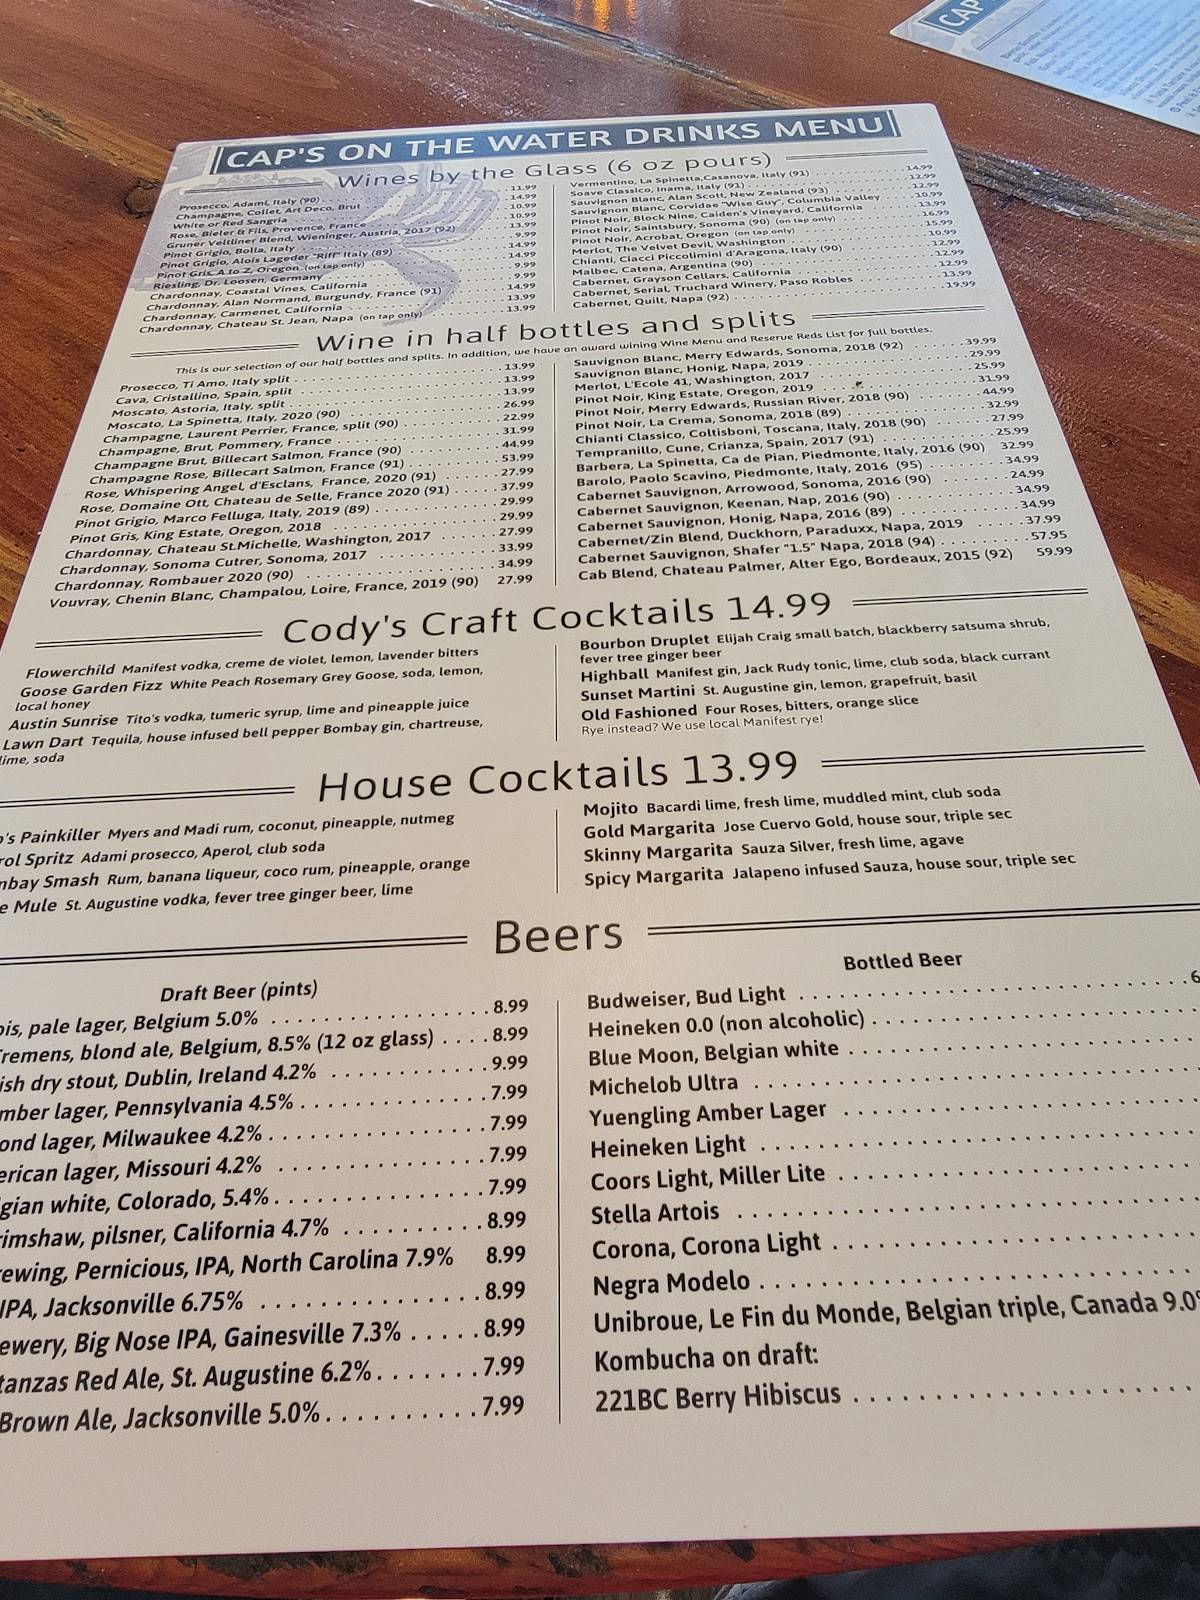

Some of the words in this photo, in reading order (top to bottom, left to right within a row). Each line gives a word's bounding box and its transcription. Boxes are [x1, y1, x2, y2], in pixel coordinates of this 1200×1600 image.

[226, 146, 326, 168] CAP'S
[338, 141, 392, 161] ON
[405, 136, 475, 157] THE
[487, 129, 613, 152] WATER
[625, 122, 761, 145] DRINKS
[774, 116, 883, 138] MENU
[337, 171, 419, 188] Wines
[430, 168, 461, 188] by
[470, 166, 514, 185] the
[524, 162, 597, 180] Glass
[607, 158, 632, 177] (6
[642, 159, 675, 171] oz
[684, 151, 771, 173] pours)
[178, 203, 230, 211] Prosecco,
[231, 199, 270, 208] Adami,
[272, 198, 298, 206] Italy
[299, 196, 320, 205] (90)
[510, 184, 537, 192] 11.99
[152, 280, 202, 290] Riesling,
[203, 279, 221, 287] Dr.
[223, 277, 267, 286] Loosen,
[270, 273, 324, 283] Germany
[514, 261, 536, 269] 9.99
[572, 267, 619, 276] Malbec,
[621, 265, 666, 273] Catena,
[669, 261, 727, 272] Argentina
[730, 258, 753, 269] (90)
[935, 248, 965, 257] 12.99
[572, 299, 631, 309] Cabernet,
[634, 296, 668, 306] Quilt,
[670, 295, 703, 304] Napa
[706, 292, 730, 303] (92)
[945, 280, 976, 289] 19.99
[316, 333, 394, 352] Wine
[407, 329, 433, 347] in
[446, 324, 508, 345] half
[519, 319, 630, 341] bottles
[641, 313, 699, 334] and
[711, 310, 796, 334] splits
[119, 383, 179, 392] Prosecco,
[182, 380, 194, 389] Ti
[196, 380, 229, 388] Amo,
[232, 377, 260, 387] Italy
[262, 375, 290, 386] split
[504, 362, 535, 371] 13.99
[574, 381, 621, 392] Merlot,
[624, 378, 669, 389] L'Ecole
[673, 377, 692, 387] 41,
[694, 374, 776, 385] Washington,
[778, 371, 809, 381] 2017
[973, 361, 1006, 370] 25.99
[577, 520, 643, 532] Cabernet
[647, 516, 725, 529] Sauvignon,
[729, 512, 776, 525] Honig,
[779, 511, 823, 523] Napa,
[825, 508, 861, 519] 2016
[865, 505, 892, 519] (89)
[1019, 499, 1056, 509] 34.99
[50, 597, 111, 608] Vouvray,
[115, 592, 166, 605] Chenin
[170, 591, 214, 602] Blanc,
[218, 585, 306, 600] Champalou,
[310, 583, 351, 595] Loire,
[355, 582, 408, 593] France,
[411, 578, 447, 590] 2019
[451, 575, 479, 590] (90)
[497, 574, 533, 585] 27.99
[283, 614, 406, 647] Cody's
[422, 607, 517, 636] Craft
[533, 597, 714, 630] Cocktails
[727, 592, 831, 621] 14.99
[25, 663, 116, 679] Flowerchild
[121, 662, 177, 674] Manifest
[180, 660, 222, 671] vodka,
[225, 659, 266, 669] creme
[268, 656, 285, 667] de
[288, 655, 327, 666] violet,
[330, 653, 374, 663] lemon,
[377, 649, 435, 661] lavender
[437, 647, 479, 658] bitters
[580, 688, 633, 702] Sunset
[638, 684, 695, 699] Martini
[702, 685, 719, 696] St.
[722, 681, 789, 696] Augustine
[792, 680, 817, 694] gin,
[820, 679, 867, 690] lemon,
[869, 673, 941, 690] grapefruit,
[943, 671, 978, 683] basil
[581, 725, 604, 737] Rye
[607, 722, 659, 734] instead?
[660, 721, 682, 731] We
[684, 721, 706, 730] use
[709, 717, 741, 729] local
[743, 715, 798, 727] Manifest
[800, 714, 824, 726] rye!
[319, 772, 452, 802] House
[469, 755, 668, 795] Cocktails
[683, 750, 797, 785] 13.99
[583, 801, 638, 819] Mojito
[646, 799, 701, 814] Bacardi
[705, 798, 740, 811] lime,
[743, 795, 780, 809] fresh
[783, 795, 819, 807] lime,
[822, 790, 887, 805] muddled
[890, 789, 928, 802] mint,
[931, 787, 963, 800] club
[966, 785, 1001, 798] soda
[495, 919, 623, 954] Beers
[843, 952, 914, 971] Bottled
[918, 952, 963, 967] Beer
[160, 984, 208, 1003] Draft
[212, 984, 257, 1000] Beer
[260, 979, 318, 1002] (pints)
[587, 990, 690, 1010] Budweiser,
[695, 987, 733, 1005] Bud
[738, 985, 786, 1006] Light
[588, 1018, 680, 1038] Heineken
[685, 1016, 714, 1033] 0.0
[719, 1014, 763, 1036] (non
[768, 1008, 864, 1030] alcoholic)
[589, 1074, 682, 1096] Michelob
[687, 1073, 738, 1092] Ultra
[591, 1203, 651, 1225] Stella
[657, 1199, 720, 1222] Artois
[592, 1239, 676, 1260] Corona,
[681, 1236, 760, 1256] Corona
[766, 1230, 822, 1257] Light
[0, 1298, 37, 1321] IPA,
[42, 1291, 175, 1318] Jacksonville
[181, 1289, 243, 1312] 6.75%
[485, 1280, 526, 1301] 8.99
[594, 1309, 703, 1334] Unibroue,
[709, 1308, 735, 1329] Le
[741, 1304, 775, 1328] Fin
[781, 1303, 810, 1326] du
[815, 1300, 900, 1326] Monde,
[905, 1297, 992, 1326] Belgian
[997, 1294, 1066, 1323] triple,
[1070, 1290, 1159, 1315] Canada
[595, 1345, 715, 1372] Kombucha
[722, 1350, 751, 1368] on
[757, 1341, 819, 1366] draft:
[595, 1387, 669, 1413] 221BC
[675, 1387, 737, 1414] Berry
[743, 1381, 841, 1407] Hibiscus
[0, 1411, 69, 1434] Brown
[73, 1406, 117, 1434] Ale,
[122, 1401, 262, 1430] Jacksonville
[268, 1400, 320, 1425] 5.0%
[482, 1394, 525, 1417] 7.99
